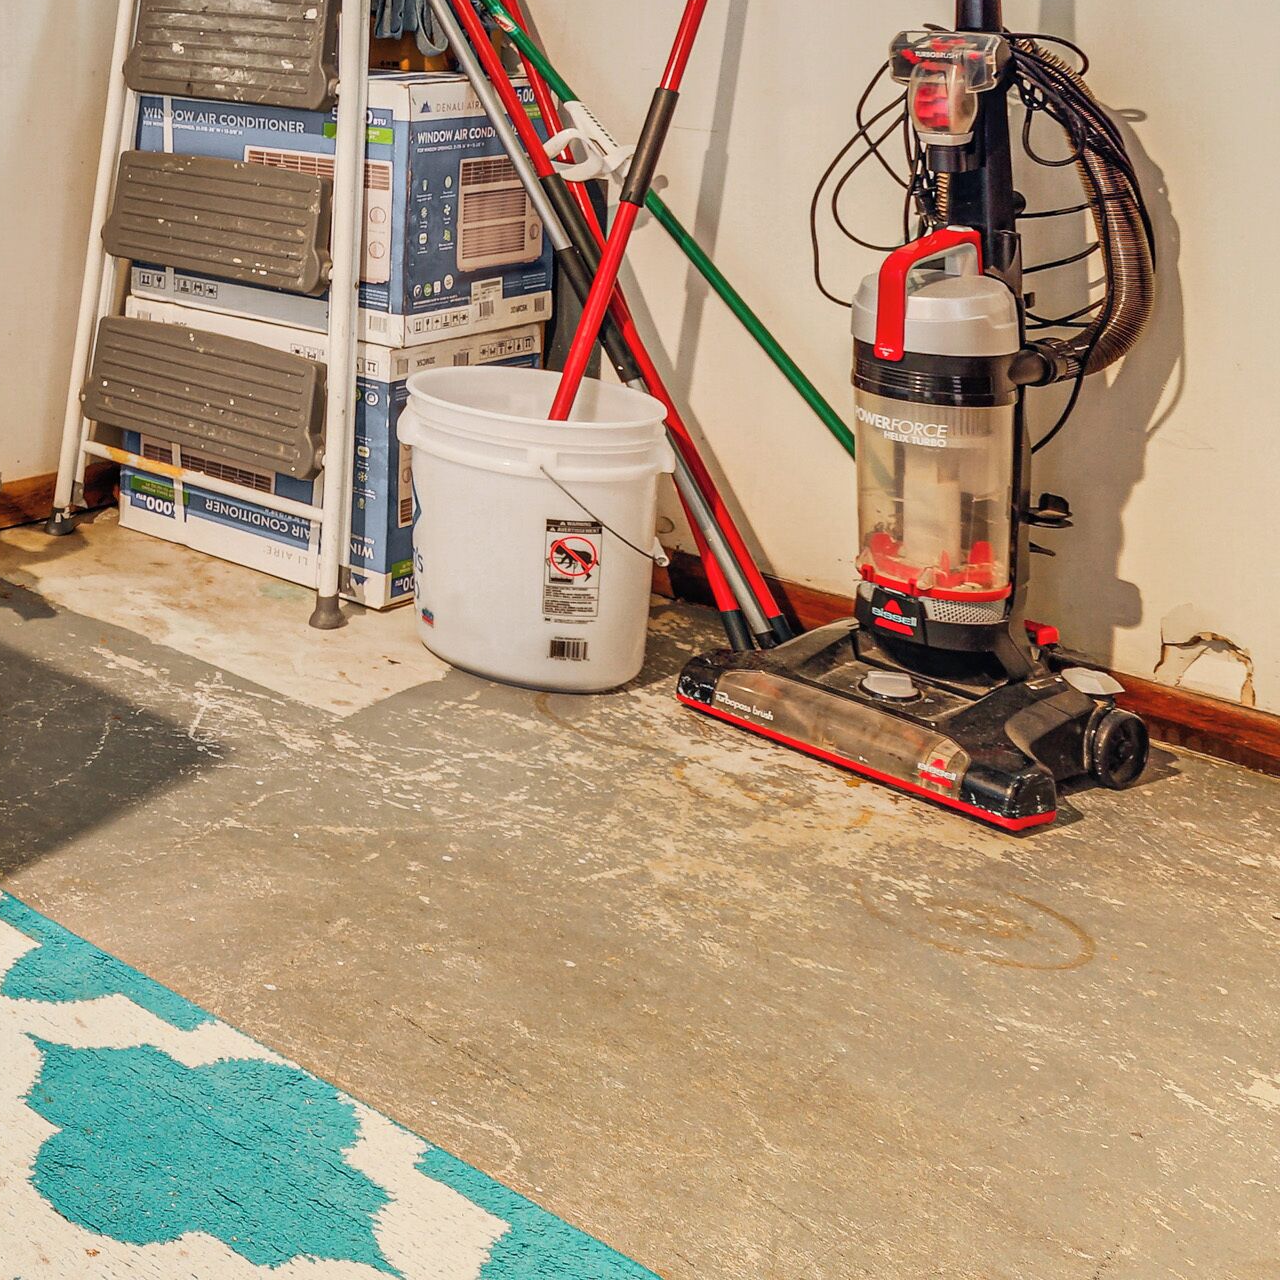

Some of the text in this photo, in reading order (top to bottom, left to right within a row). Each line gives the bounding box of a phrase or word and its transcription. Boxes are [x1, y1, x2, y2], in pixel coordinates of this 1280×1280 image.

[436, 102, 464, 113] DENALI
[195, 111, 217, 126] AIR
[219, 114, 305, 135] CONDITIONER
[417, 129, 454, 145] WINDOW
[454, 128, 468, 141] AIR
[883, 430, 947, 448] HELIX TURBO
[204, 498, 289, 534] CONDITIONER
[291, 521, 311, 541] AIR
[265, 545, 292, 562] AIRE
[350, 543, 374, 560] WIN
[752, 705, 774, 721] brush
